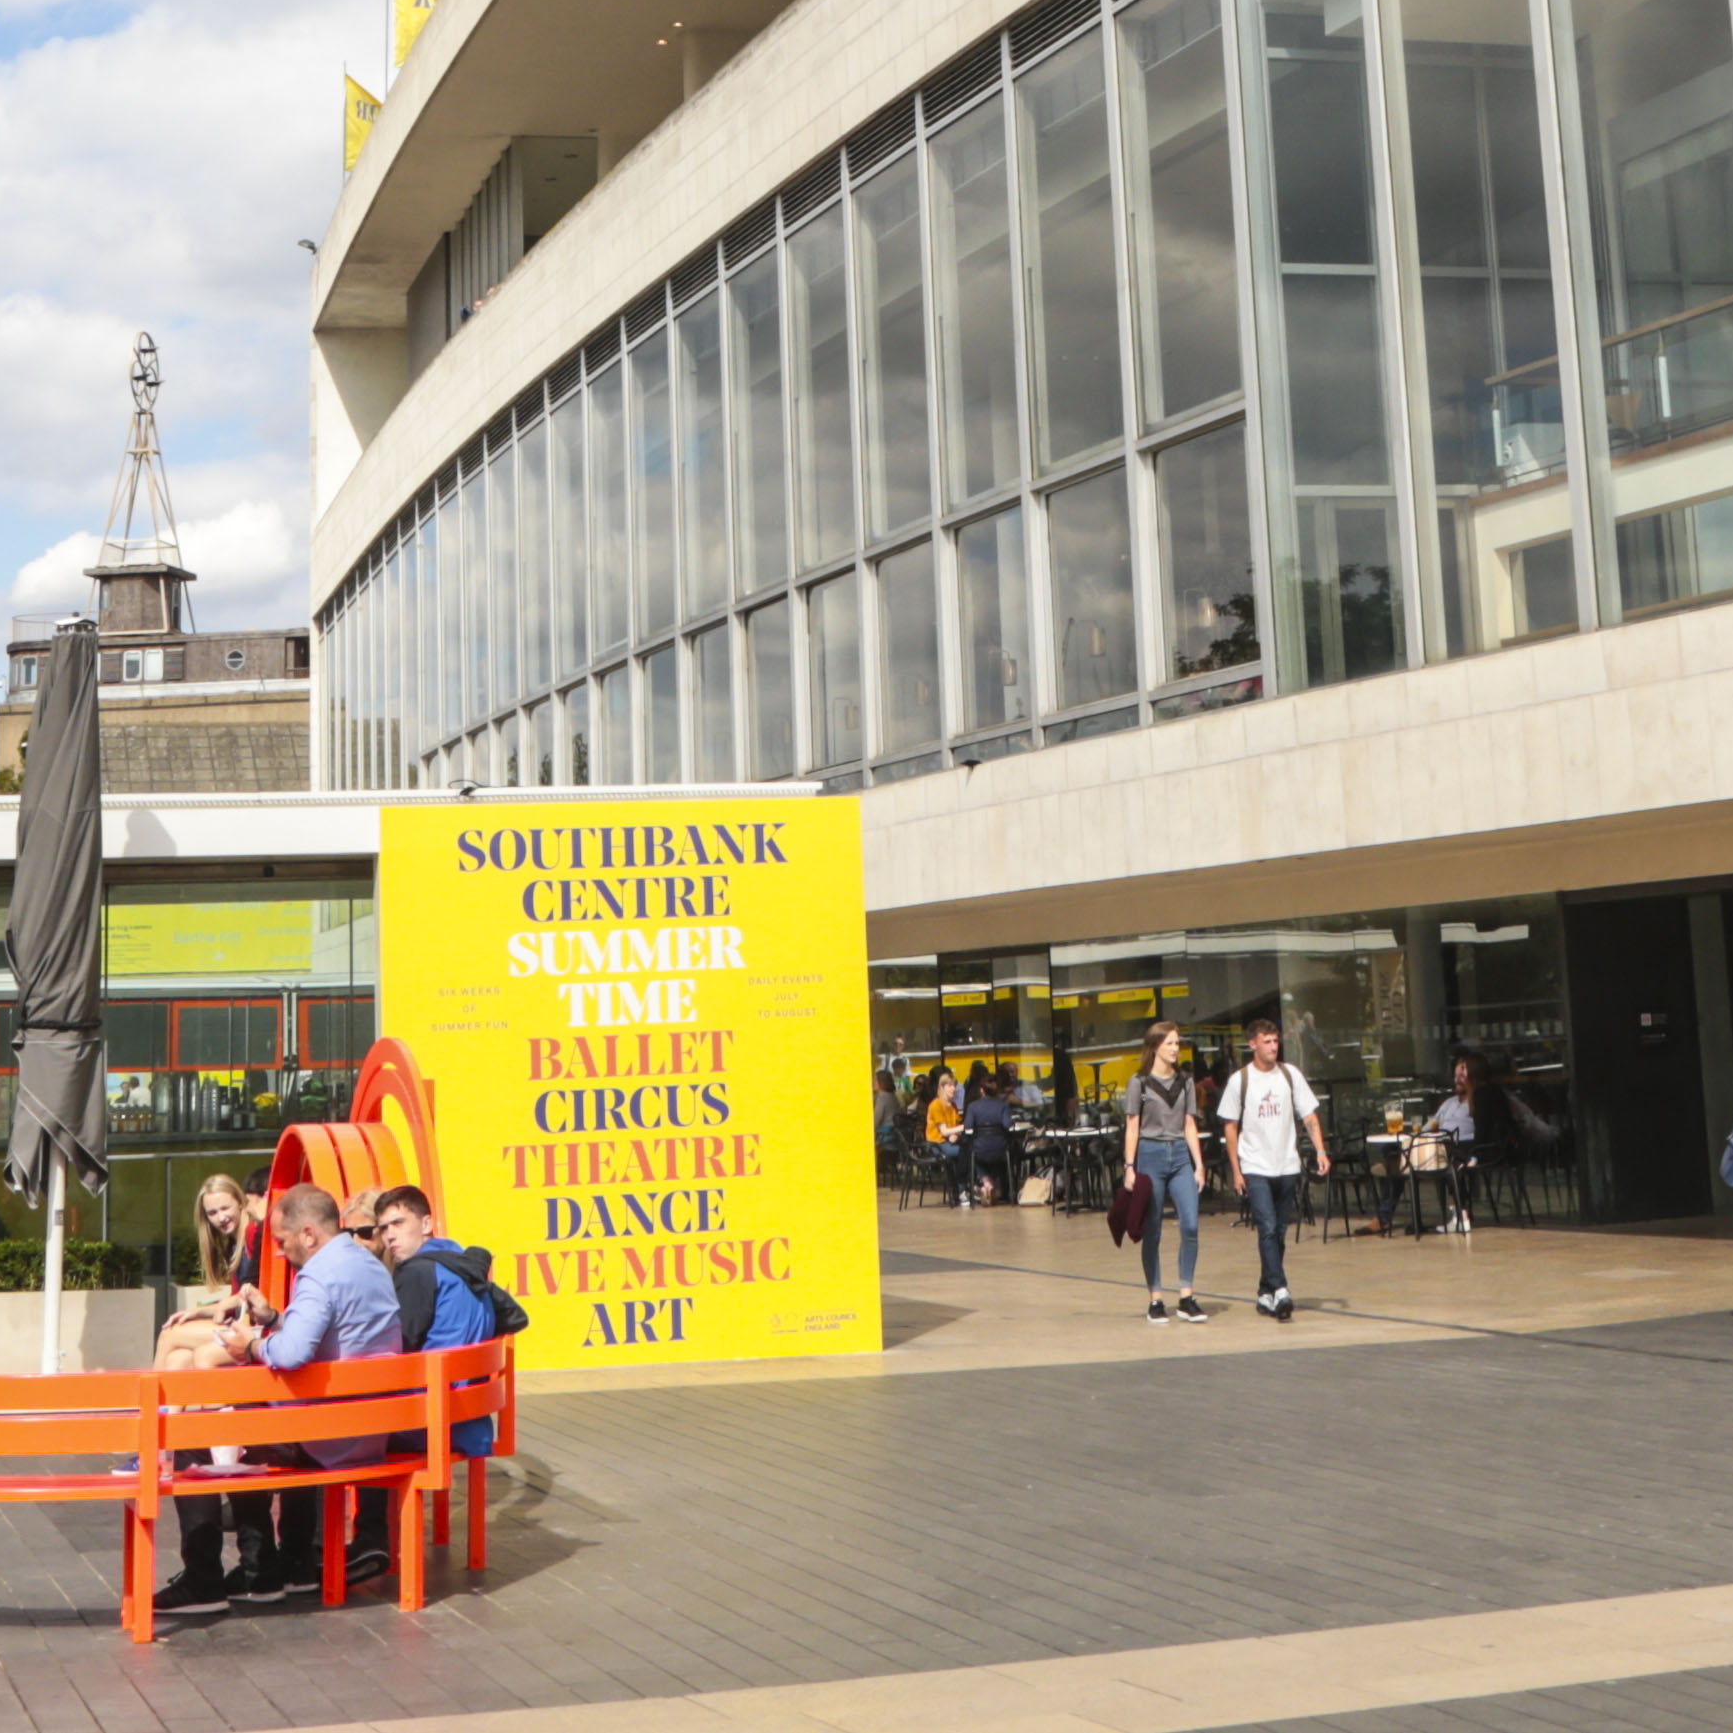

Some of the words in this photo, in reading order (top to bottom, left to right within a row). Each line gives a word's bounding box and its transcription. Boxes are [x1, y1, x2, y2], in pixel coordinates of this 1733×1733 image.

[457, 822, 788, 872] SOUTHBANK
[522, 875, 730, 923] CENTRE
[507, 925, 747, 977] SUMMER
[438, 988, 456, 997] SIX
[461, 986, 500, 996] WEEKS
[558, 979, 697, 1028] TIME
[748, 976, 778, 986] DAILY
[782, 973, 824, 984] EVENTS
[775, 992, 799, 1001] JULY
[431, 1022, 481, 1032] SUMMER
[486, 1020, 509, 1029] FUN
[462, 1005, 476, 1014] OF
[758, 1009, 771, 1018] TO
[775, 1007, 817, 1018] AUGUST
[527, 1030, 734, 1081] BALLET
[534, 1083, 730, 1134] CIRCUS
[502, 1134, 762, 1188] THEATRE
[545, 1189, 725, 1241] DANCE
[621, 1237, 791, 1291] MUSIC
[582, 1297, 693, 1347] ART
[804, 1322, 841, 1331] ENGLAND
[805, 1315, 824, 1323] ARTS
